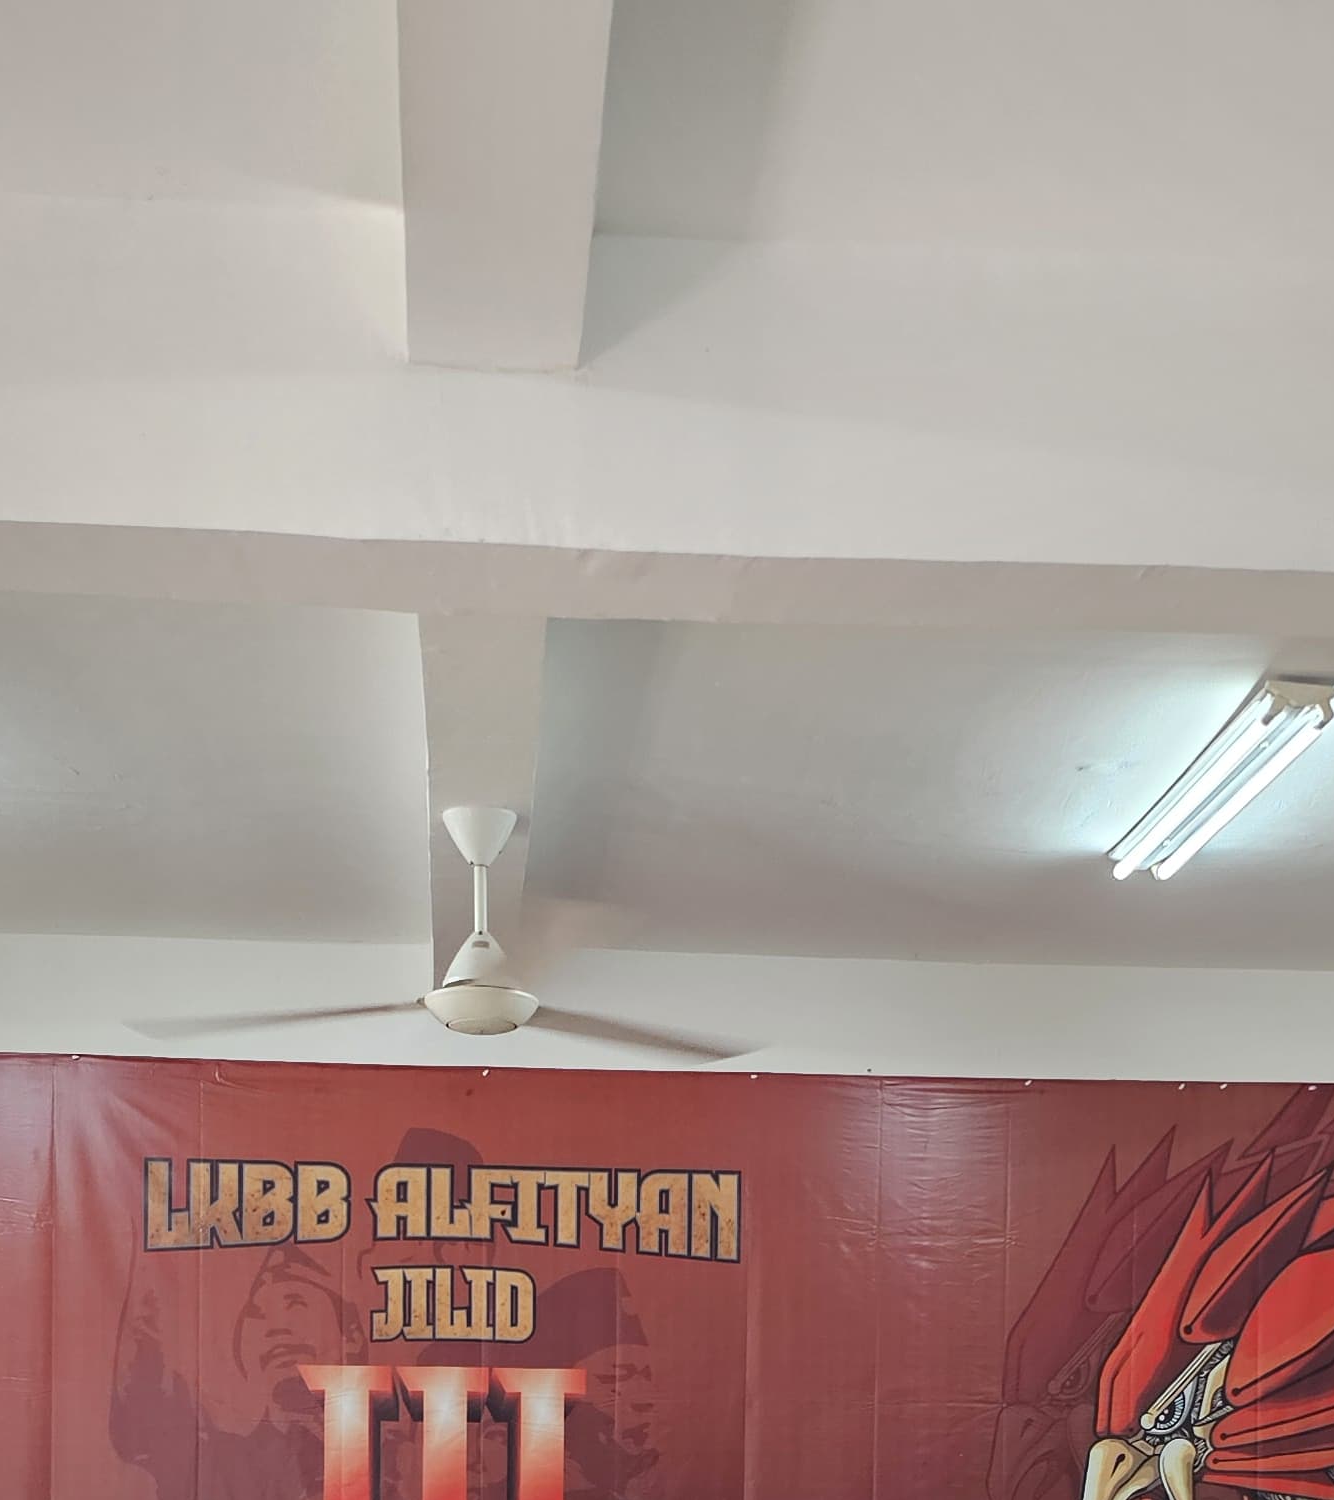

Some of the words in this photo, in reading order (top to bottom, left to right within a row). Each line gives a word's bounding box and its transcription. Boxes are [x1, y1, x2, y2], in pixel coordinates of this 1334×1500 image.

[143, 1157, 351, 1252] LKBB
[366, 1165, 742, 1263] ALFITYAN
[370, 1266, 535, 1344] JILID
